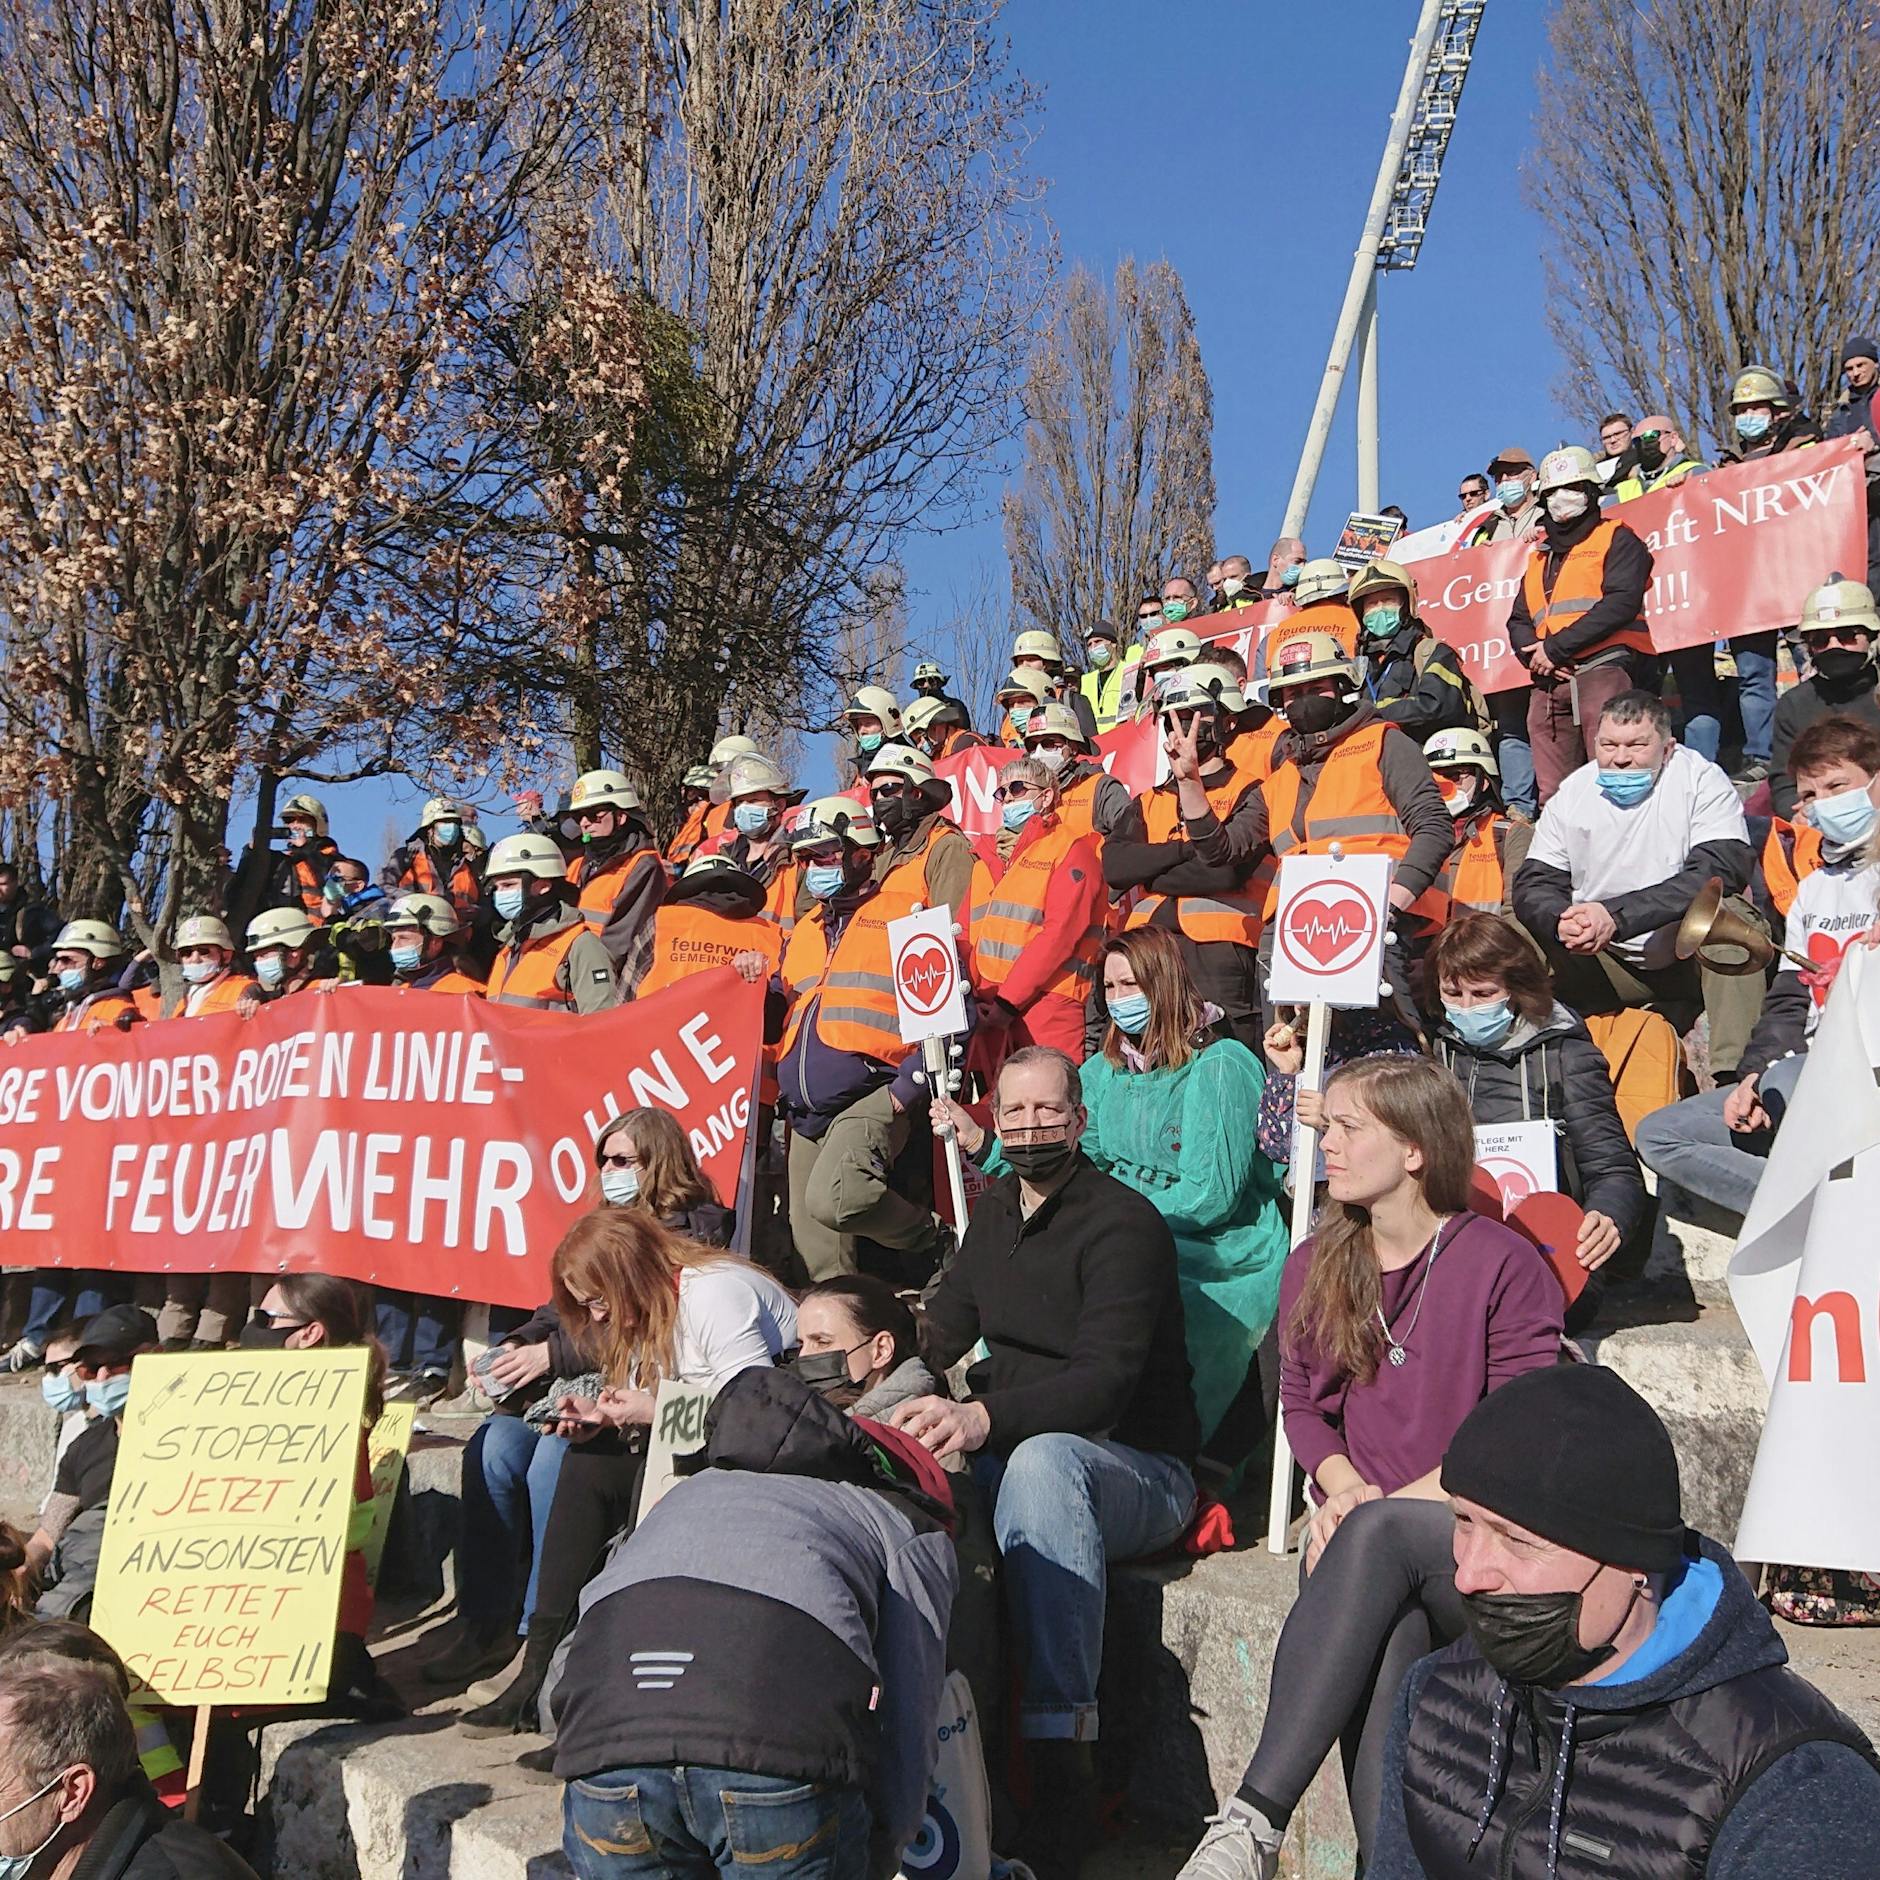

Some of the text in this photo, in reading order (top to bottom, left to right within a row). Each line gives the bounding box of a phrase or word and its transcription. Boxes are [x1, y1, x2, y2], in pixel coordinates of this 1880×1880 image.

[1713, 464, 1844, 535] NRW
[1279, 624, 1348, 636] feuerwehr
[672, 937, 756, 956] feuerw
[228, 1031, 354, 1111] ROTEN
[689, 1087, 749, 1168] ANG
[1507, 1135, 1524, 1144] MIT
[1484, 1145, 1510, 1153] HERZ
[106, 1128, 533, 1256] FEUERWEHR
[659, 1394, 711, 1445] FREI
[142, 1423, 350, 1464] STOPPEN
[152, 1471, 295, 1517] JETZT
[119, 1534, 343, 1576] ANSONSTEN
[137, 1584, 303, 1622] RETTET
[173, 1624, 261, 1649] EUCH
